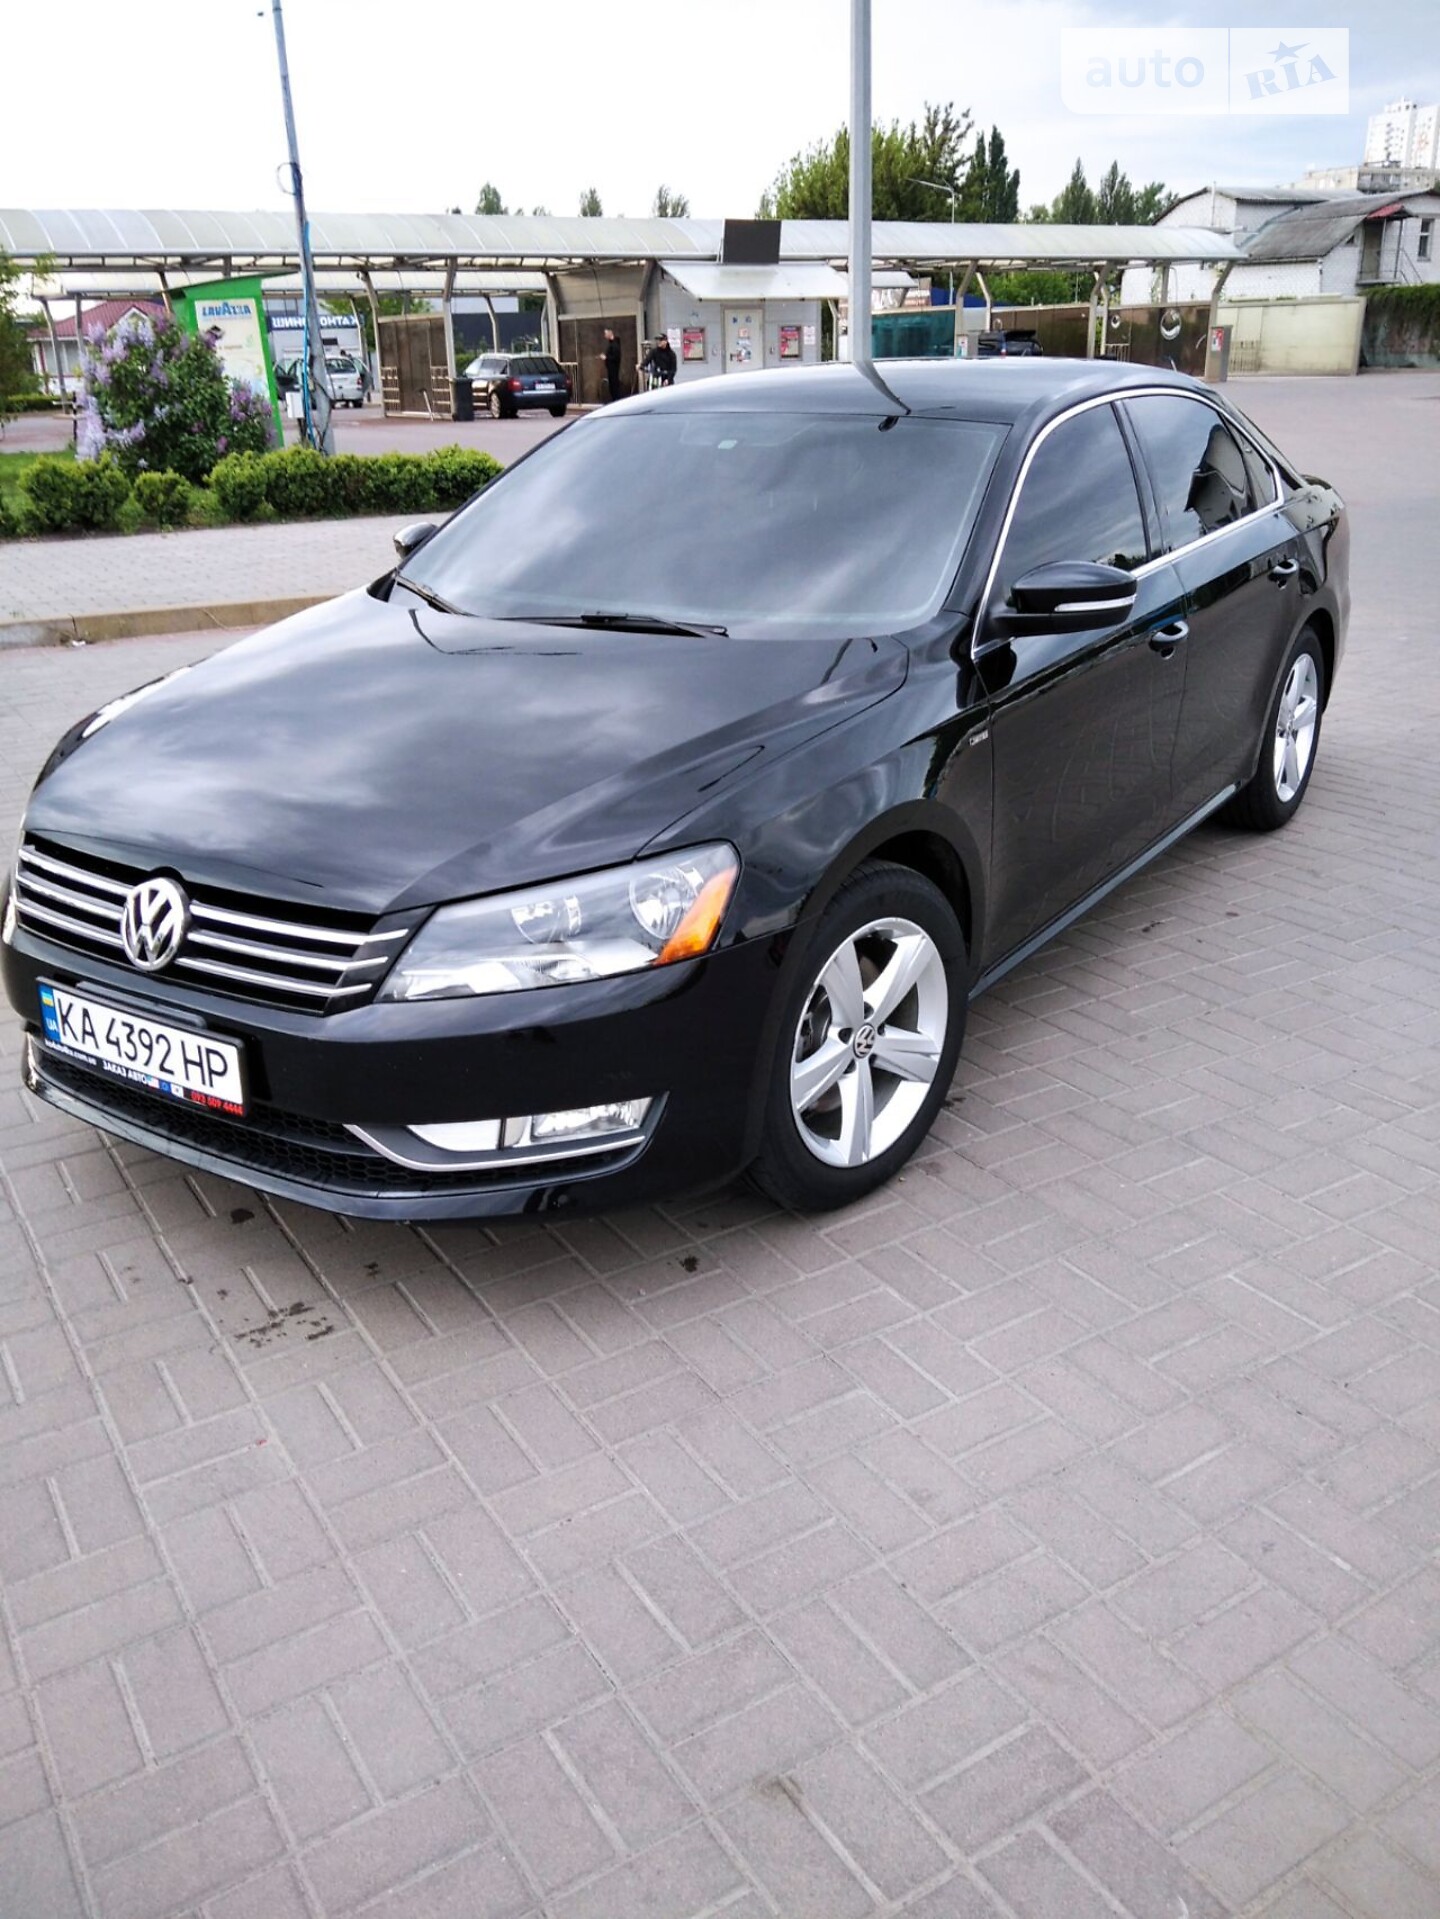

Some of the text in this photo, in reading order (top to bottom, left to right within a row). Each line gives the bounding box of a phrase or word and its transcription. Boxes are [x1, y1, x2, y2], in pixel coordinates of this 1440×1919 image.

[272, 313, 360, 329] ШИНОНТАЖ
[57, 997, 100, 1050] KA
[105, 1017, 175, 1076] 4392
[180, 1039, 228, 1088] HP
